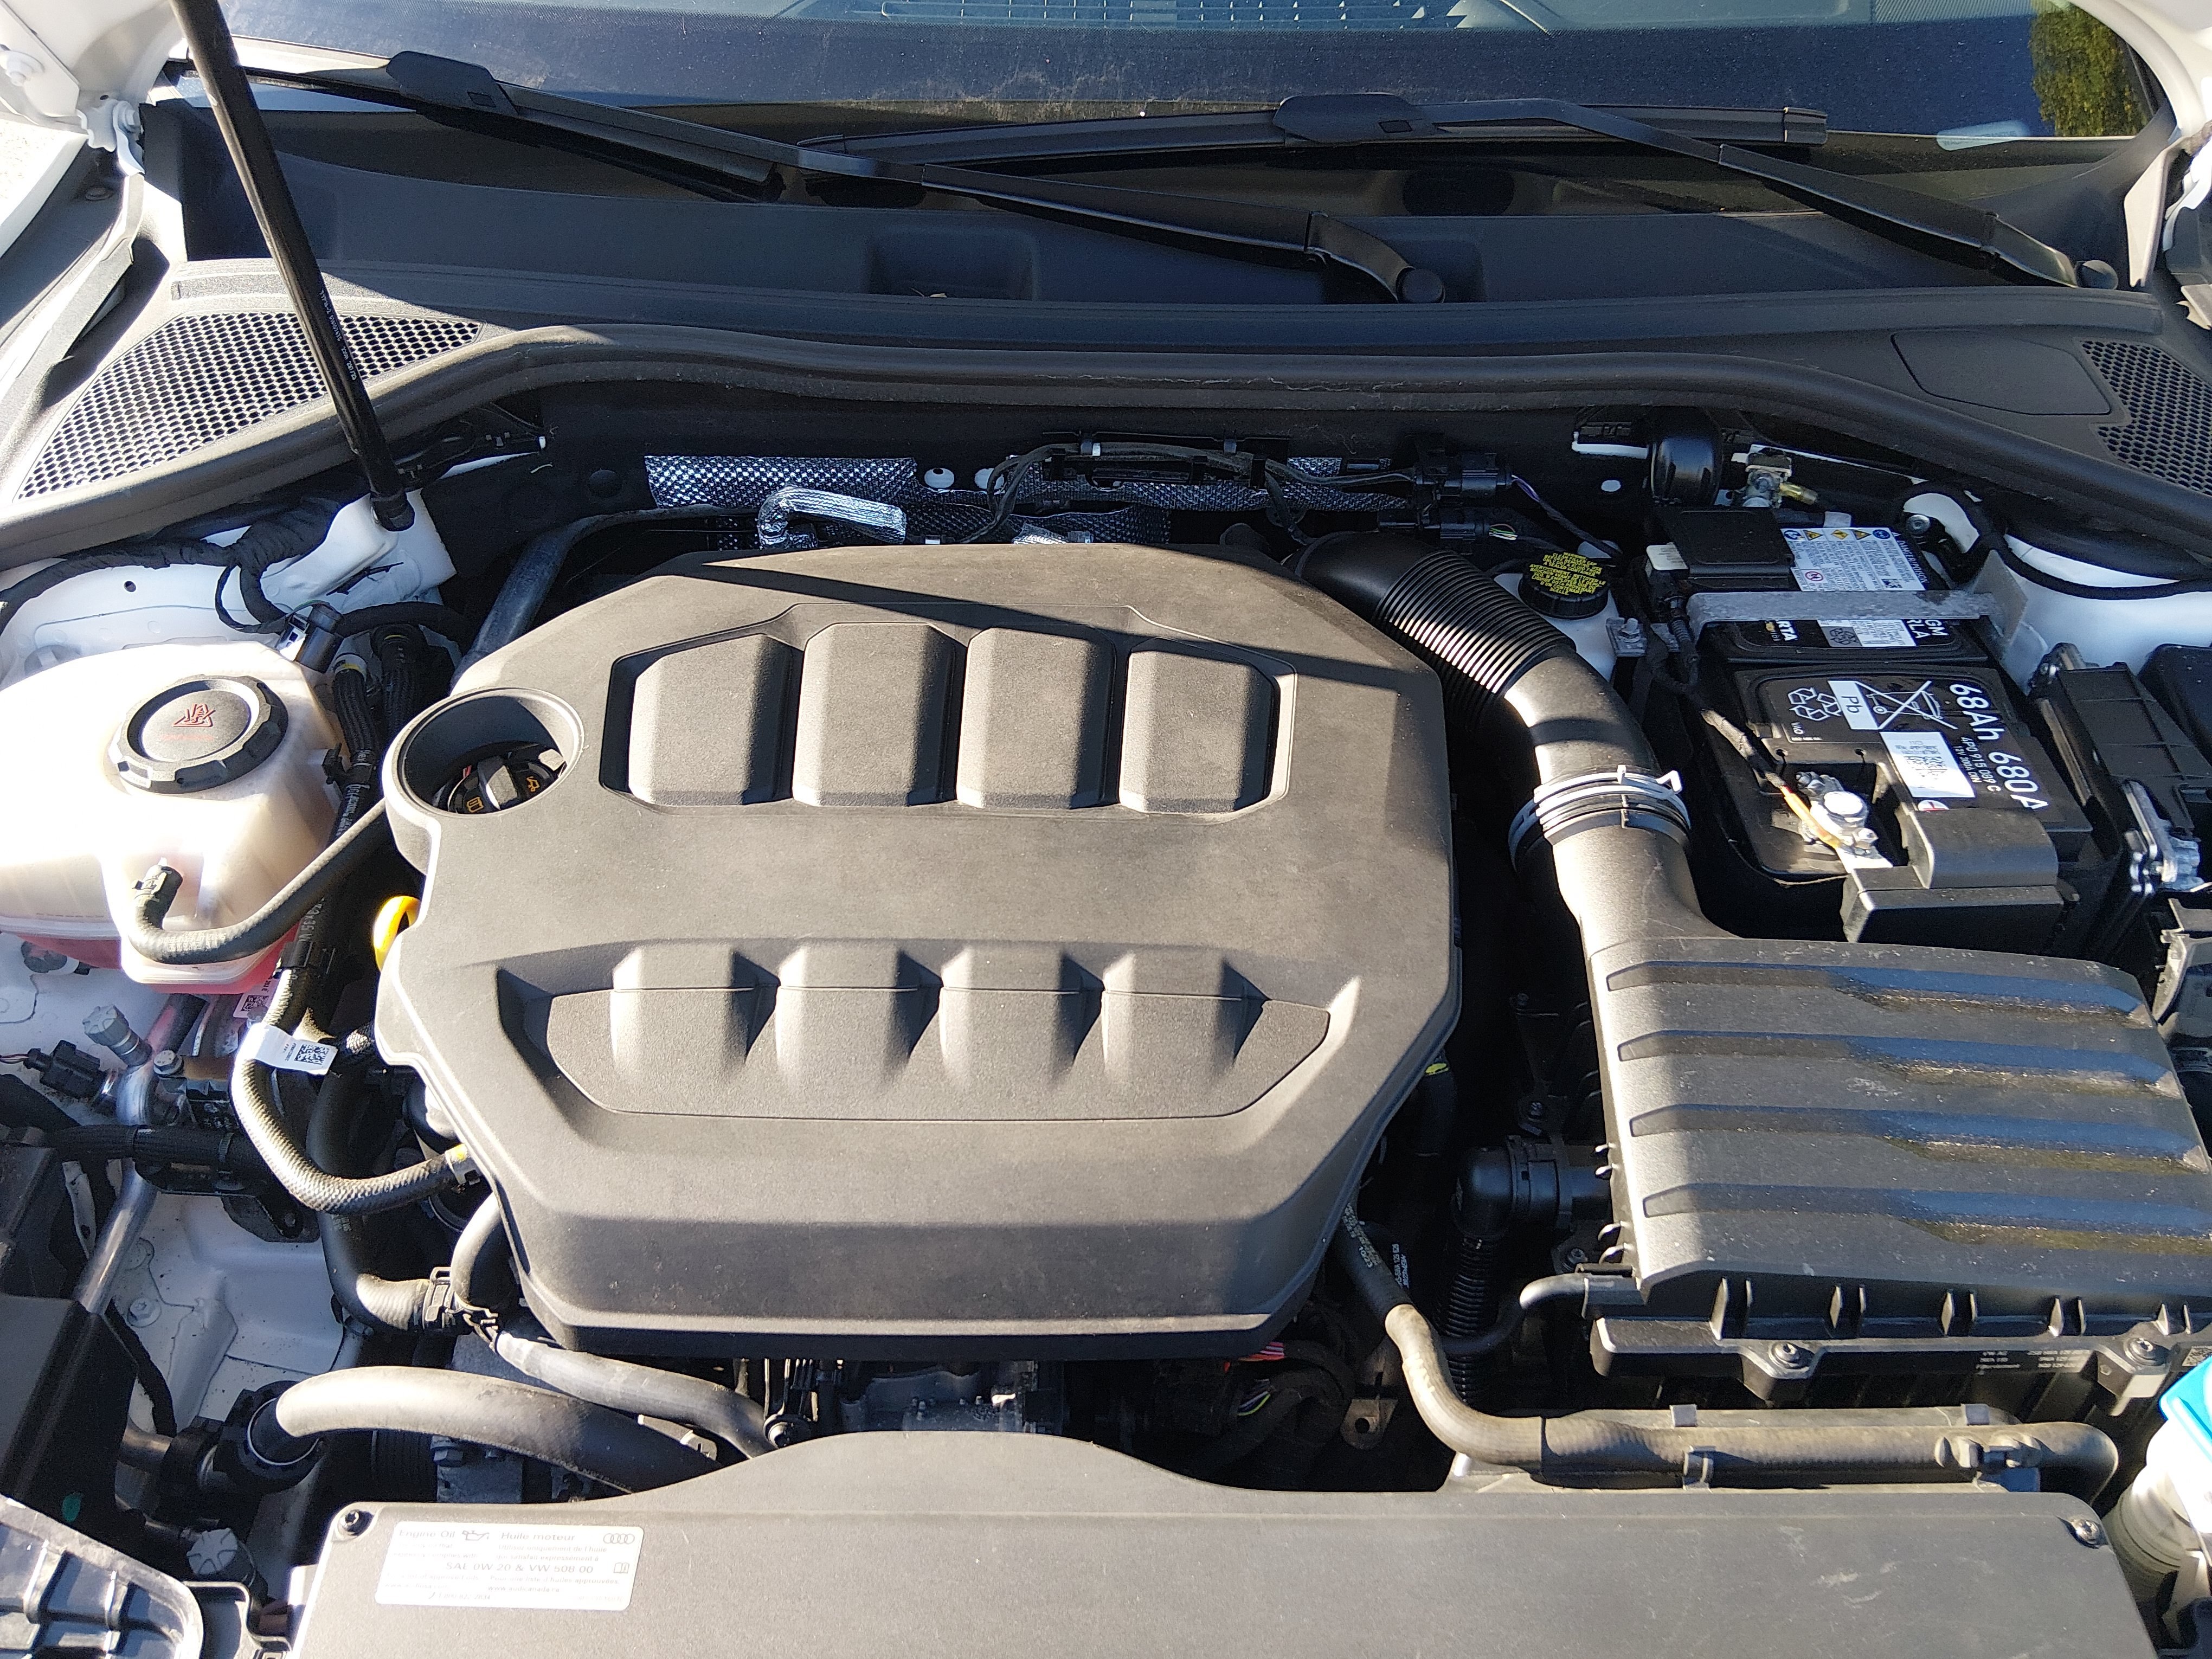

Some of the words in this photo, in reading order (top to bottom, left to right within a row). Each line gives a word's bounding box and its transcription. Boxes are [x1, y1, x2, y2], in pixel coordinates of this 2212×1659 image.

[1898, 540, 1930, 583] DANGER/POISON
[1776, 620, 1799, 641] RTA
[1924, 619, 1949, 636] GM
[1841, 696, 1863, 713] Pb
[1950, 684, 2005, 740] 68Ah
[1988, 751, 2049, 809] 680A
[1967, 771, 1983, 783] DIN
[440, 1530, 455, 1538] Oil
[501, 1532, 529, 1540] Huile
[446, 1562, 468, 1570] SAE
[515, 1564, 524, 1572] &
[554, 1565, 575, 1573] 508
[579, 1565, 594, 1573] 00
